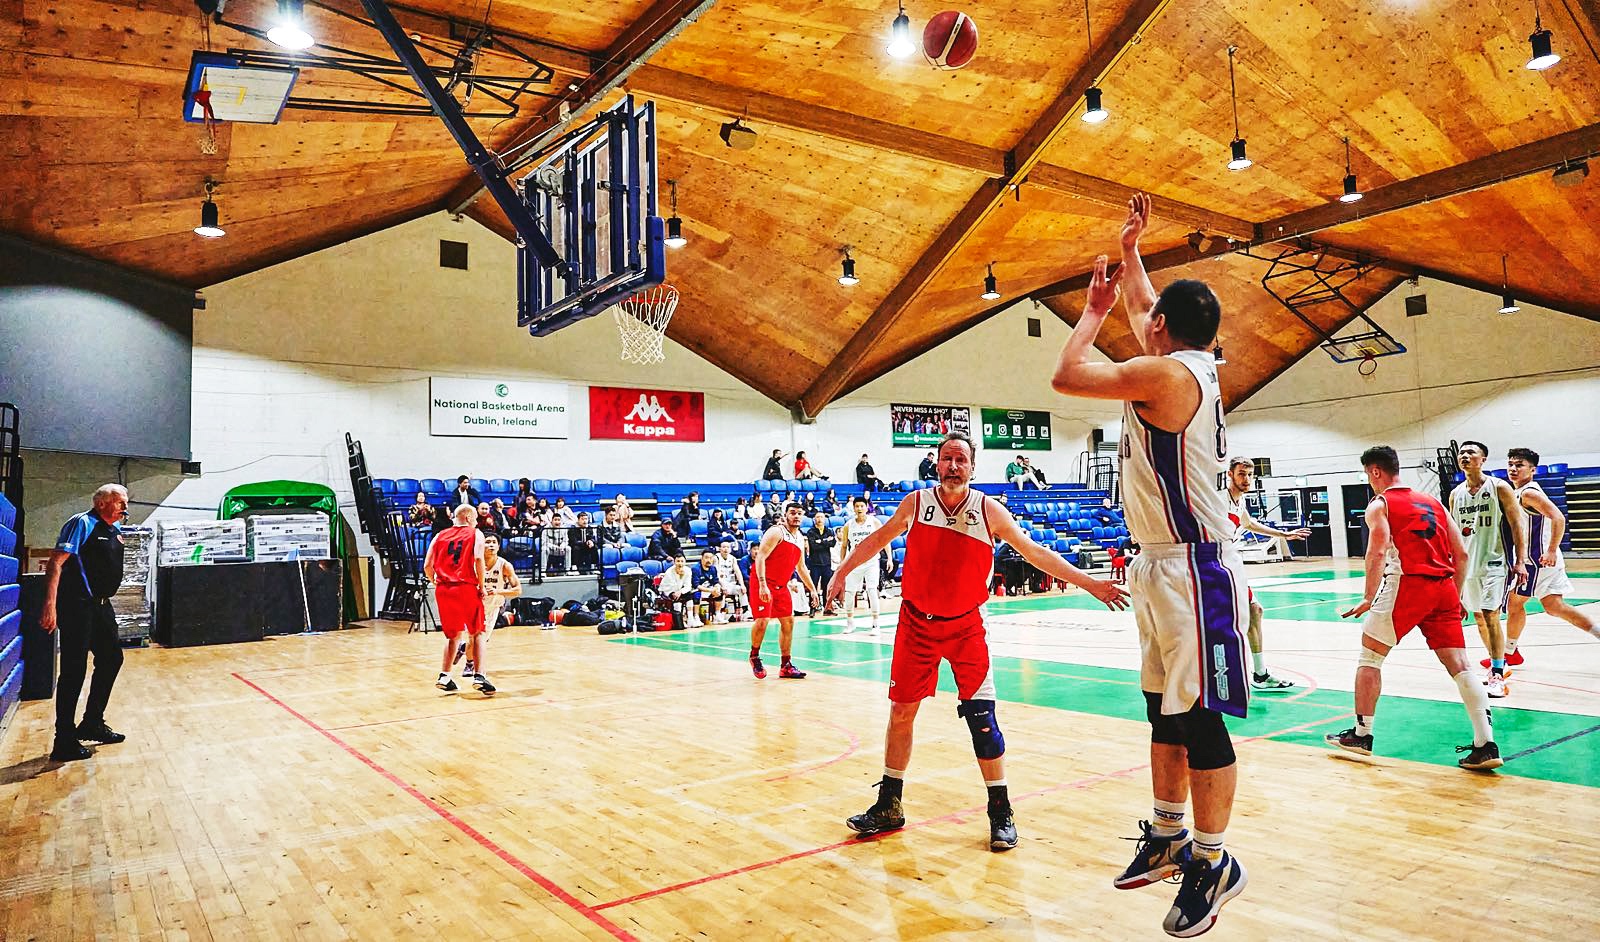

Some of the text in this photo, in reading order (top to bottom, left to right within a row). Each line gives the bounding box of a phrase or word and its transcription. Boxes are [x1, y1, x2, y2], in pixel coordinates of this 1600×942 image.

[434, 399, 565, 412] National Basketball Arena
[464, 415, 537, 426] Dublin, Ireland
[623, 424, 675, 436] Kappa
[924, 505, 935, 522] 8
[1409, 502, 1437, 540] 3
[1478, 515, 1492, 527] 10
[448, 540, 463, 564] 4
